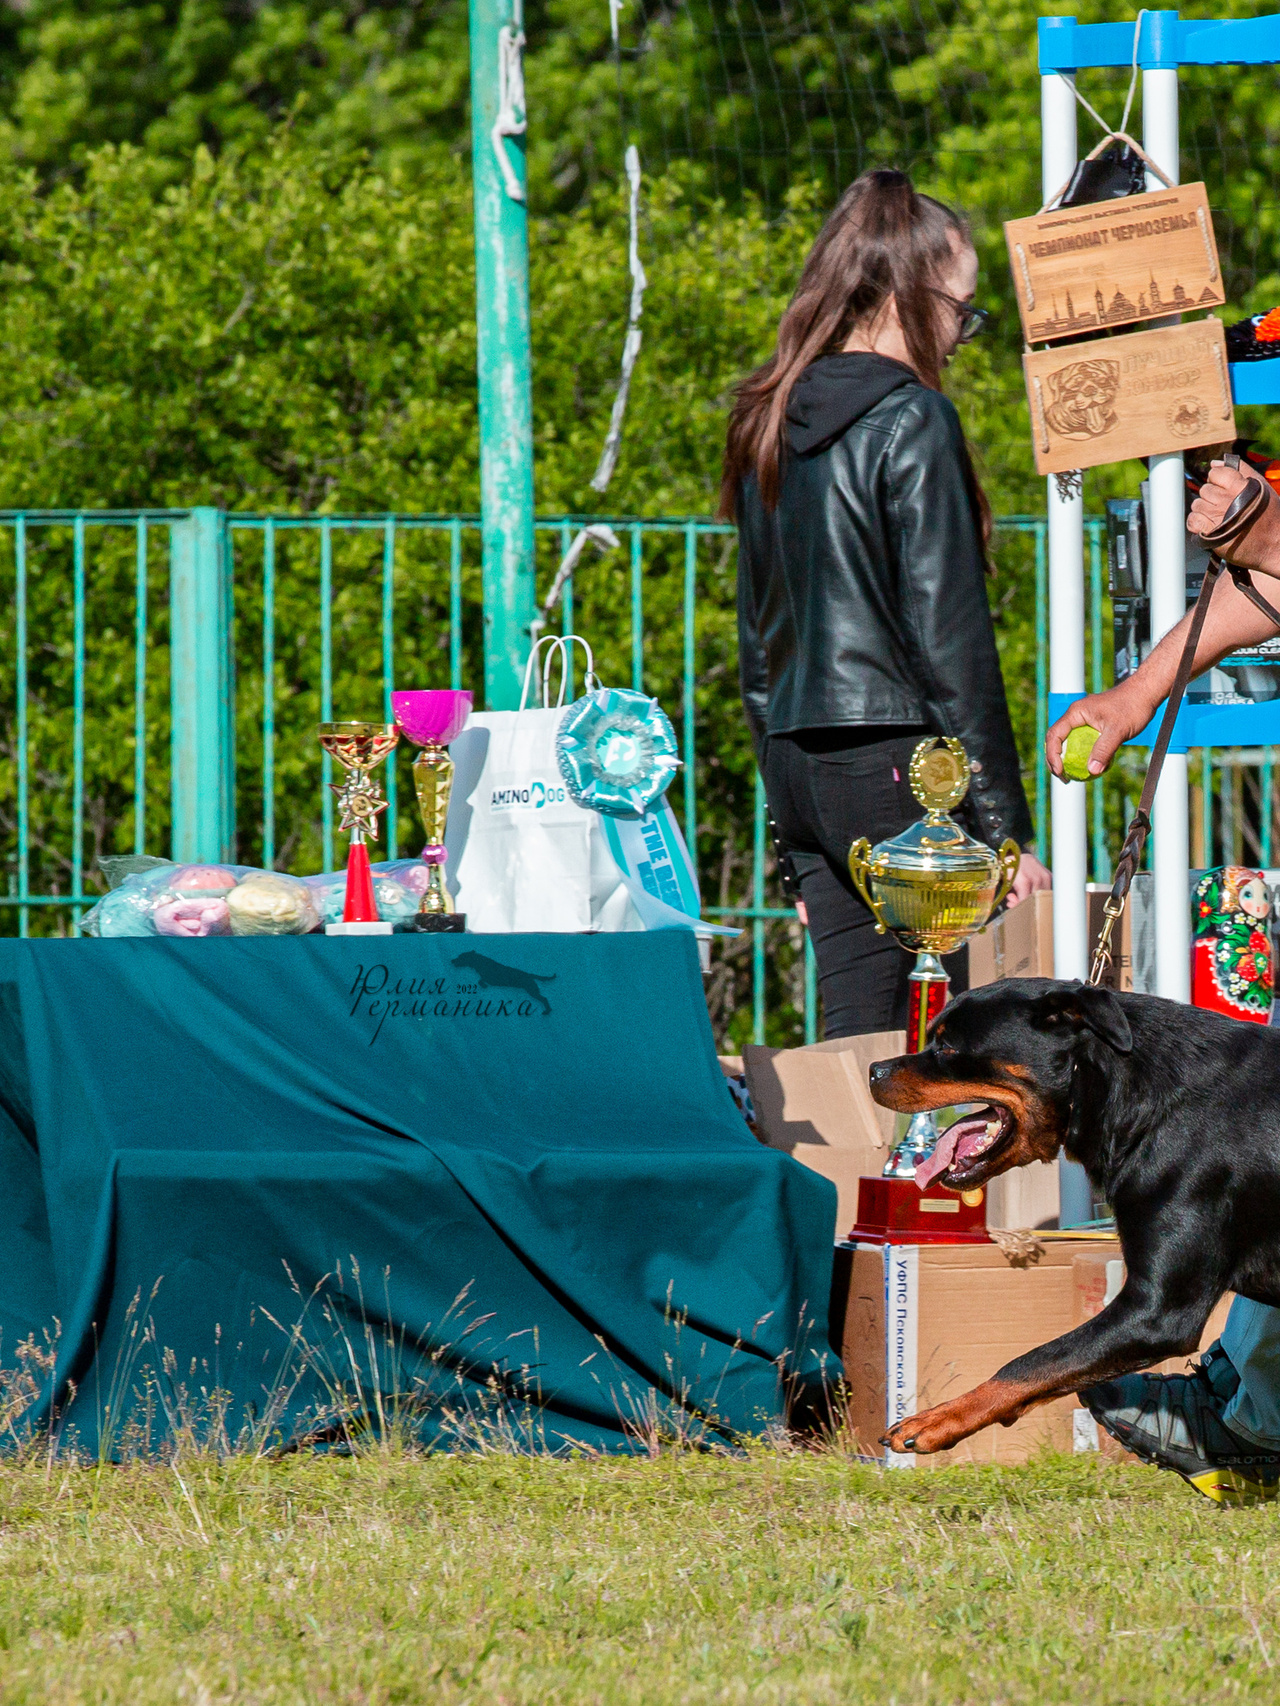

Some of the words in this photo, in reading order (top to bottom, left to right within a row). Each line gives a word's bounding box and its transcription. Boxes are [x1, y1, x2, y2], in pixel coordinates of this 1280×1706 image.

[1029, 229, 1109, 258] ЧЕМПИОНАТ
[1110, 211, 1198, 242] ЧЕРНОЗЕМЬЯ
[641, 820, 668, 863] THE
[896, 1259, 908, 1304] УФПС
[896, 1308, 908, 1389] Псковской
[896, 1393, 908, 1421] обл
